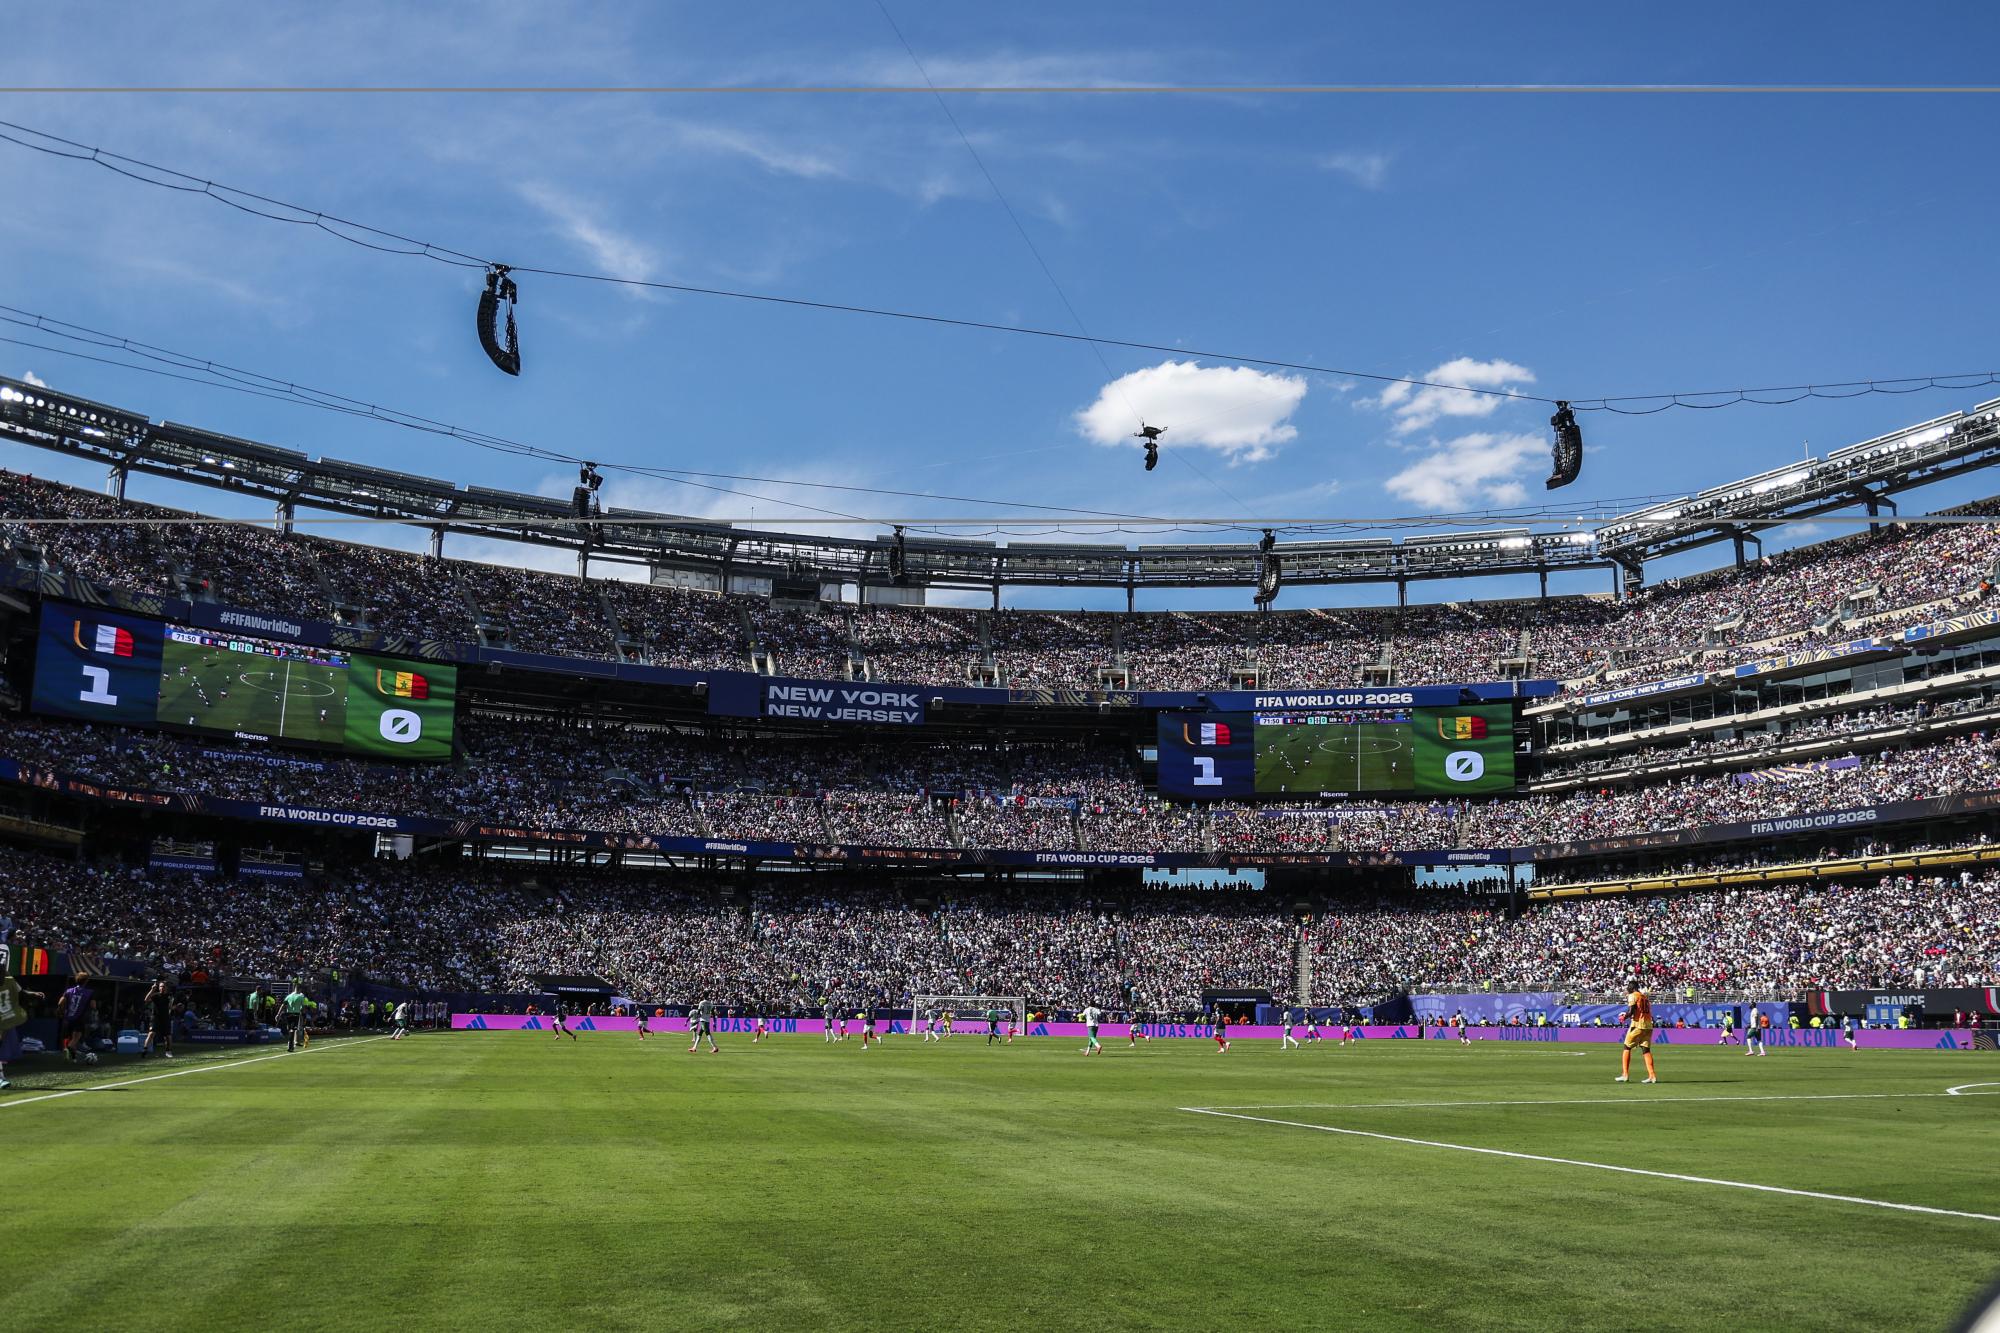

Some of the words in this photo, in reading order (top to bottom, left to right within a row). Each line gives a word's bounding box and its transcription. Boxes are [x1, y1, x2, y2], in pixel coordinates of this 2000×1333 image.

[220, 611, 301, 637] #FIFAWorldCup
[176, 634, 196, 643] 71:50
[80, 665, 117, 706] 1
[1590, 693, 1611, 704] NEW
[1611, 689, 1636, 700] YORK
[1638, 684, 1659, 695] NEW
[1661, 676, 1699, 690] JERSEY
[768, 685, 834, 703] NEW
[841, 690, 919, 708] YORK
[1255, 697, 1284, 707] FIFA
[1285, 695, 1335, 707] WORLD
[1336, 694, 1364, 705] CUP
[1366, 693, 1413, 704] 2026
[768, 704, 822, 718] NEW
[826, 708, 919, 723] JERSEY
[235, 731, 268, 741] Hisense
[1194, 757, 1222, 785] 1
[260, 806, 286, 818] FIFA
[288, 808, 331, 822] WORLD
[332, 813, 356, 824] CUP
[357, 815, 397, 828] 2026
[1751, 822, 1774, 834] FIFA
[1775, 817, 1813, 831] WORLD
[1814, 815, 1836, 826] CUP
[1837, 809, 1877, 824] 2026
[705, 842, 747, 852] #FIFAWorldCup
[1036, 854, 1058, 862] FIFA
[1059, 854, 1096, 863] WORLD
[1097, 855, 1118, 863] CUP
[1119, 855, 1155, 864] 2026
[1448, 853, 1490, 861] #FIFAWorldCup
[252, 868, 272, 876] WORLD
[1874, 995, 1925, 1006] FRANCE
[664, 1009, 680, 1017] IFA
[1563, 1013, 1581, 1023] FIFA
[1499, 1027, 1559, 1041] ADIDAS.COM
